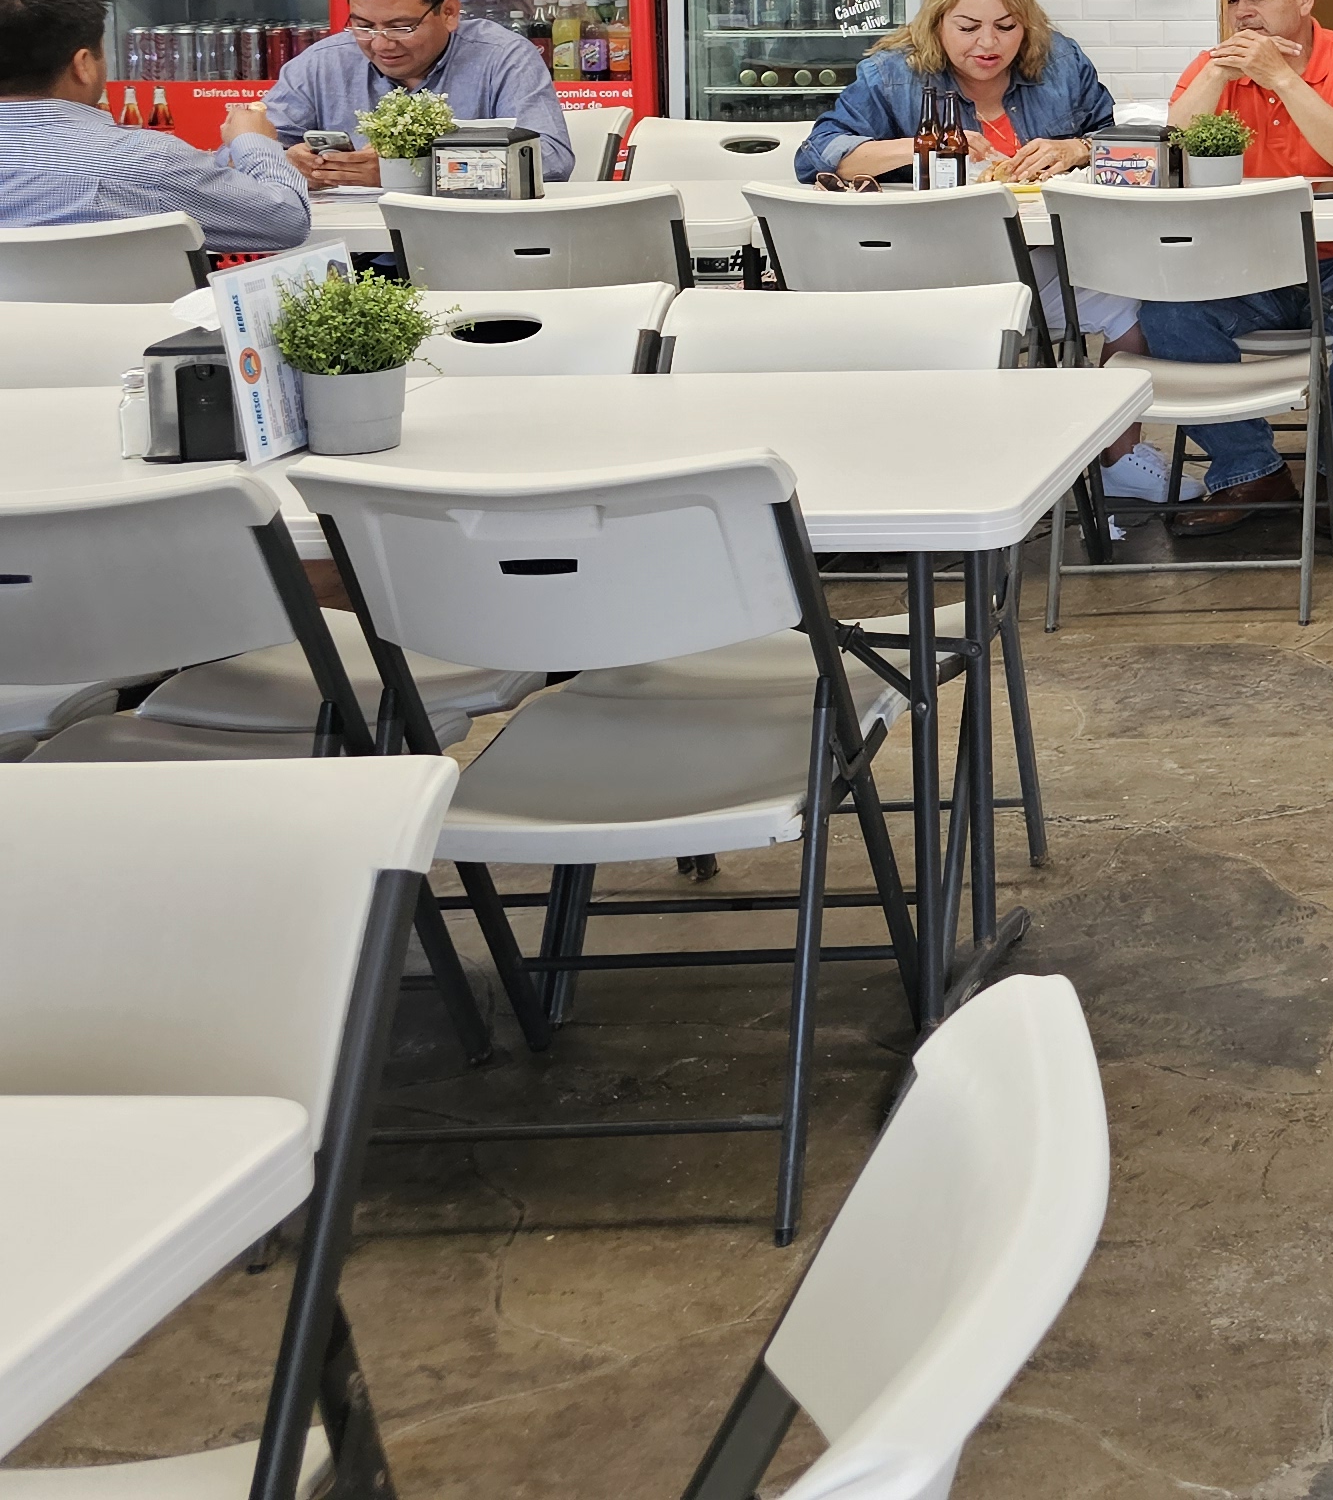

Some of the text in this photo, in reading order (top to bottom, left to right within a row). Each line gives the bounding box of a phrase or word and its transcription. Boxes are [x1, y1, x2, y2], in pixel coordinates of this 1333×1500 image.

[840, 14, 889, 38] I'm alive
[193, 88, 239, 98] Disfruta
[242, 89, 254, 98] tu
[556, 88, 633, 98] comida con el
[559, 101, 586, 110] abor
[231, 294, 247, 333] BEBIDAS
[252, 390, 264, 425] FRESCO
[261, 436, 269, 447] LO
